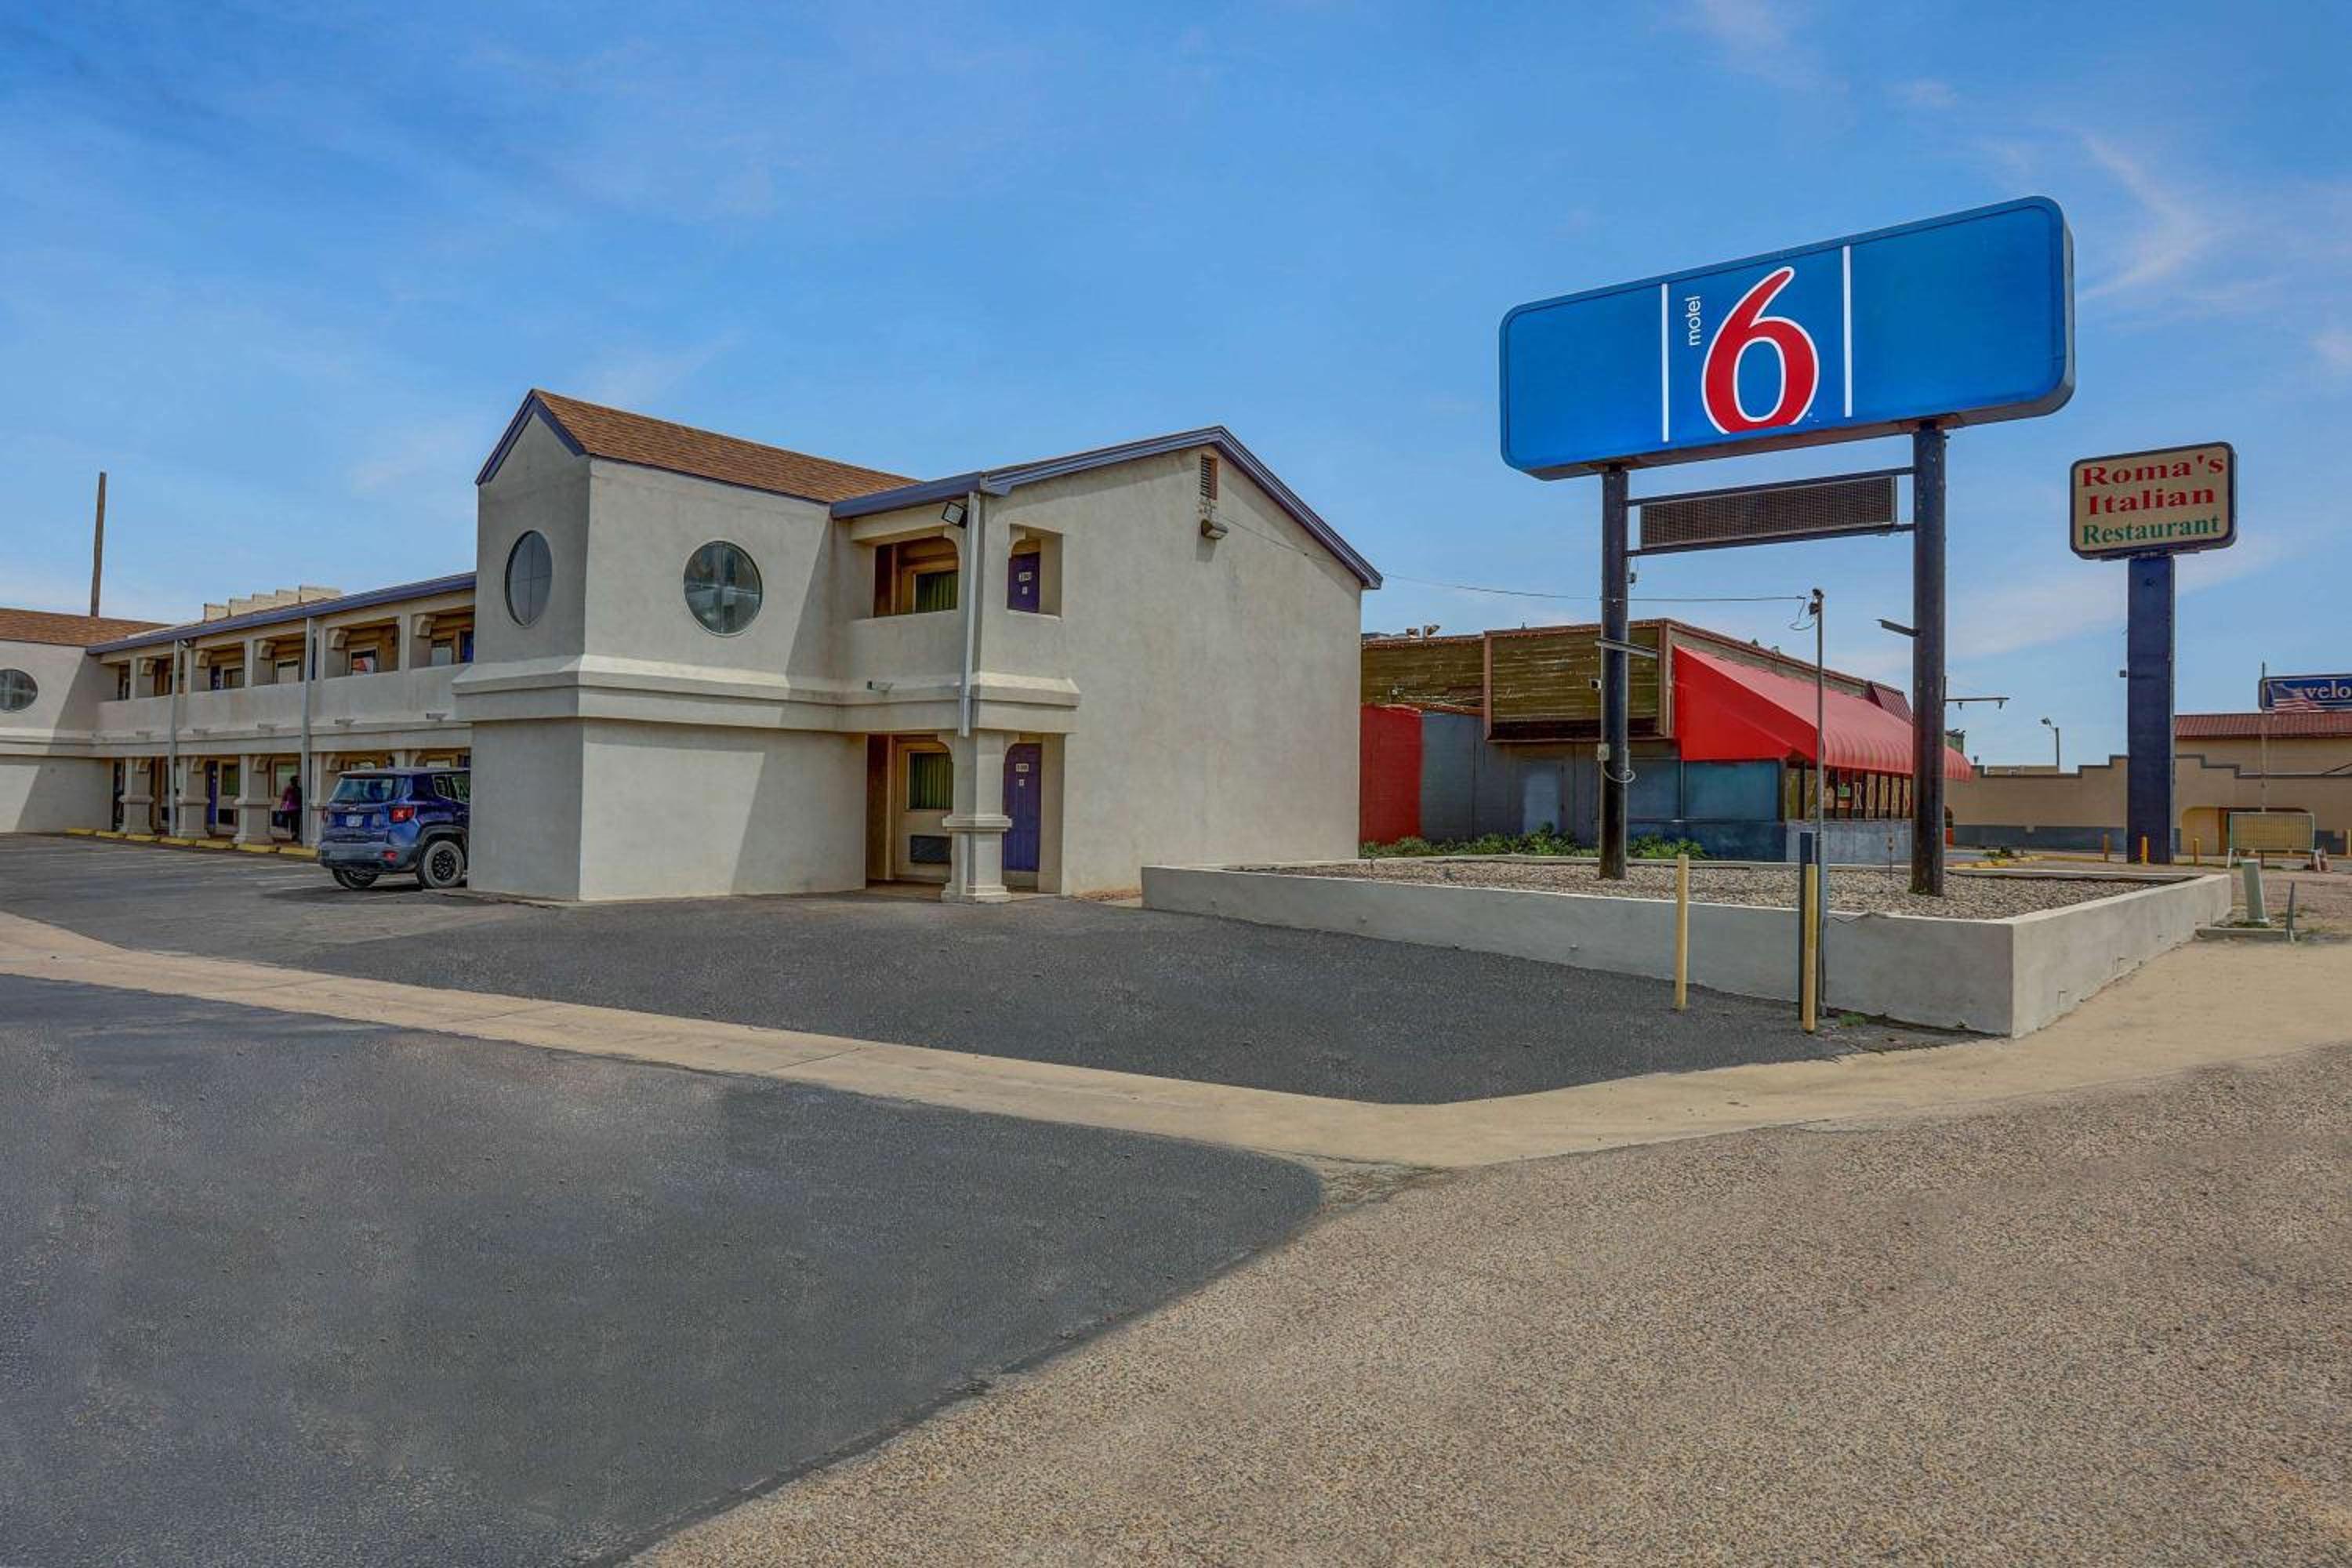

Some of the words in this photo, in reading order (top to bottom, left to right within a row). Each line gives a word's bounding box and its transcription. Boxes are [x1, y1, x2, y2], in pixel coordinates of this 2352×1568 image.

[1685, 296, 1700, 346] motel
[1700, 266, 1819, 434] 6
[2082, 454, 2224, 487] Roma's
[2089, 488, 2216, 515] Italian
[2082, 514, 2221, 545] Restaurant
